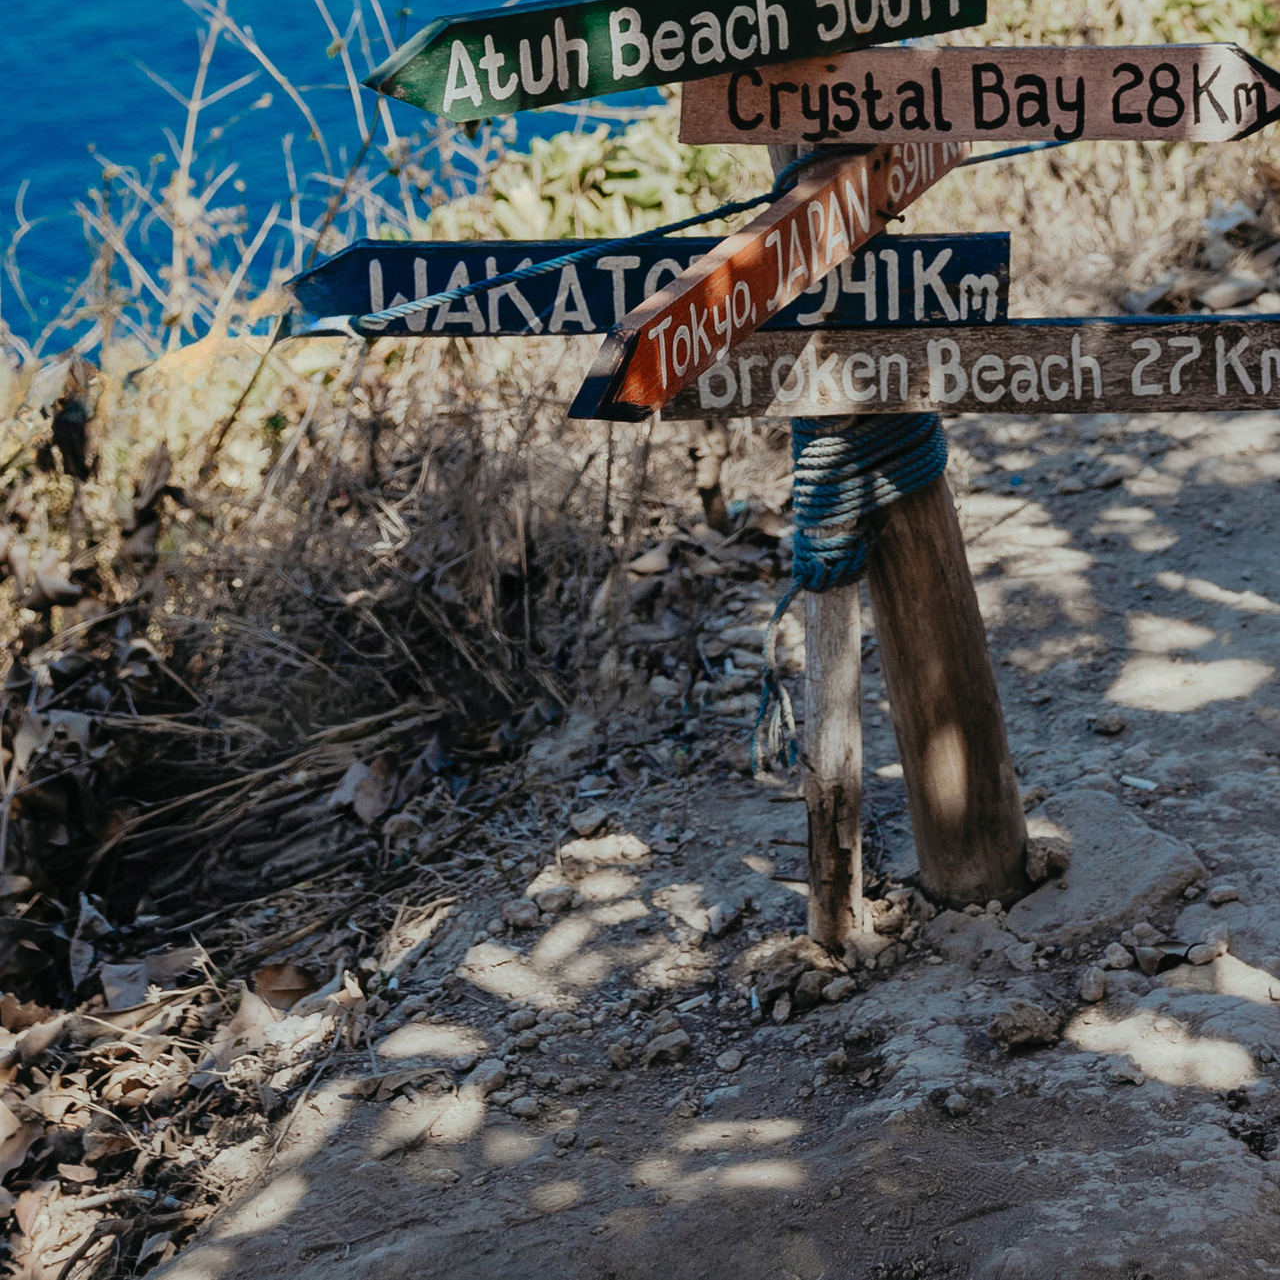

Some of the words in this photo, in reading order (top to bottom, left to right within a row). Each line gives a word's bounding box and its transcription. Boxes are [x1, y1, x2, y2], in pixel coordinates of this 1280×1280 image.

[442, 18, 589, 113] Atuh
[727, 69, 951, 142] Crystal
[972, 65, 1085, 140] Bay
[765, 166, 870, 313] JAPAN
[927, 335, 1101, 404] Beach
[1131, 337, 1200, 396] 27
